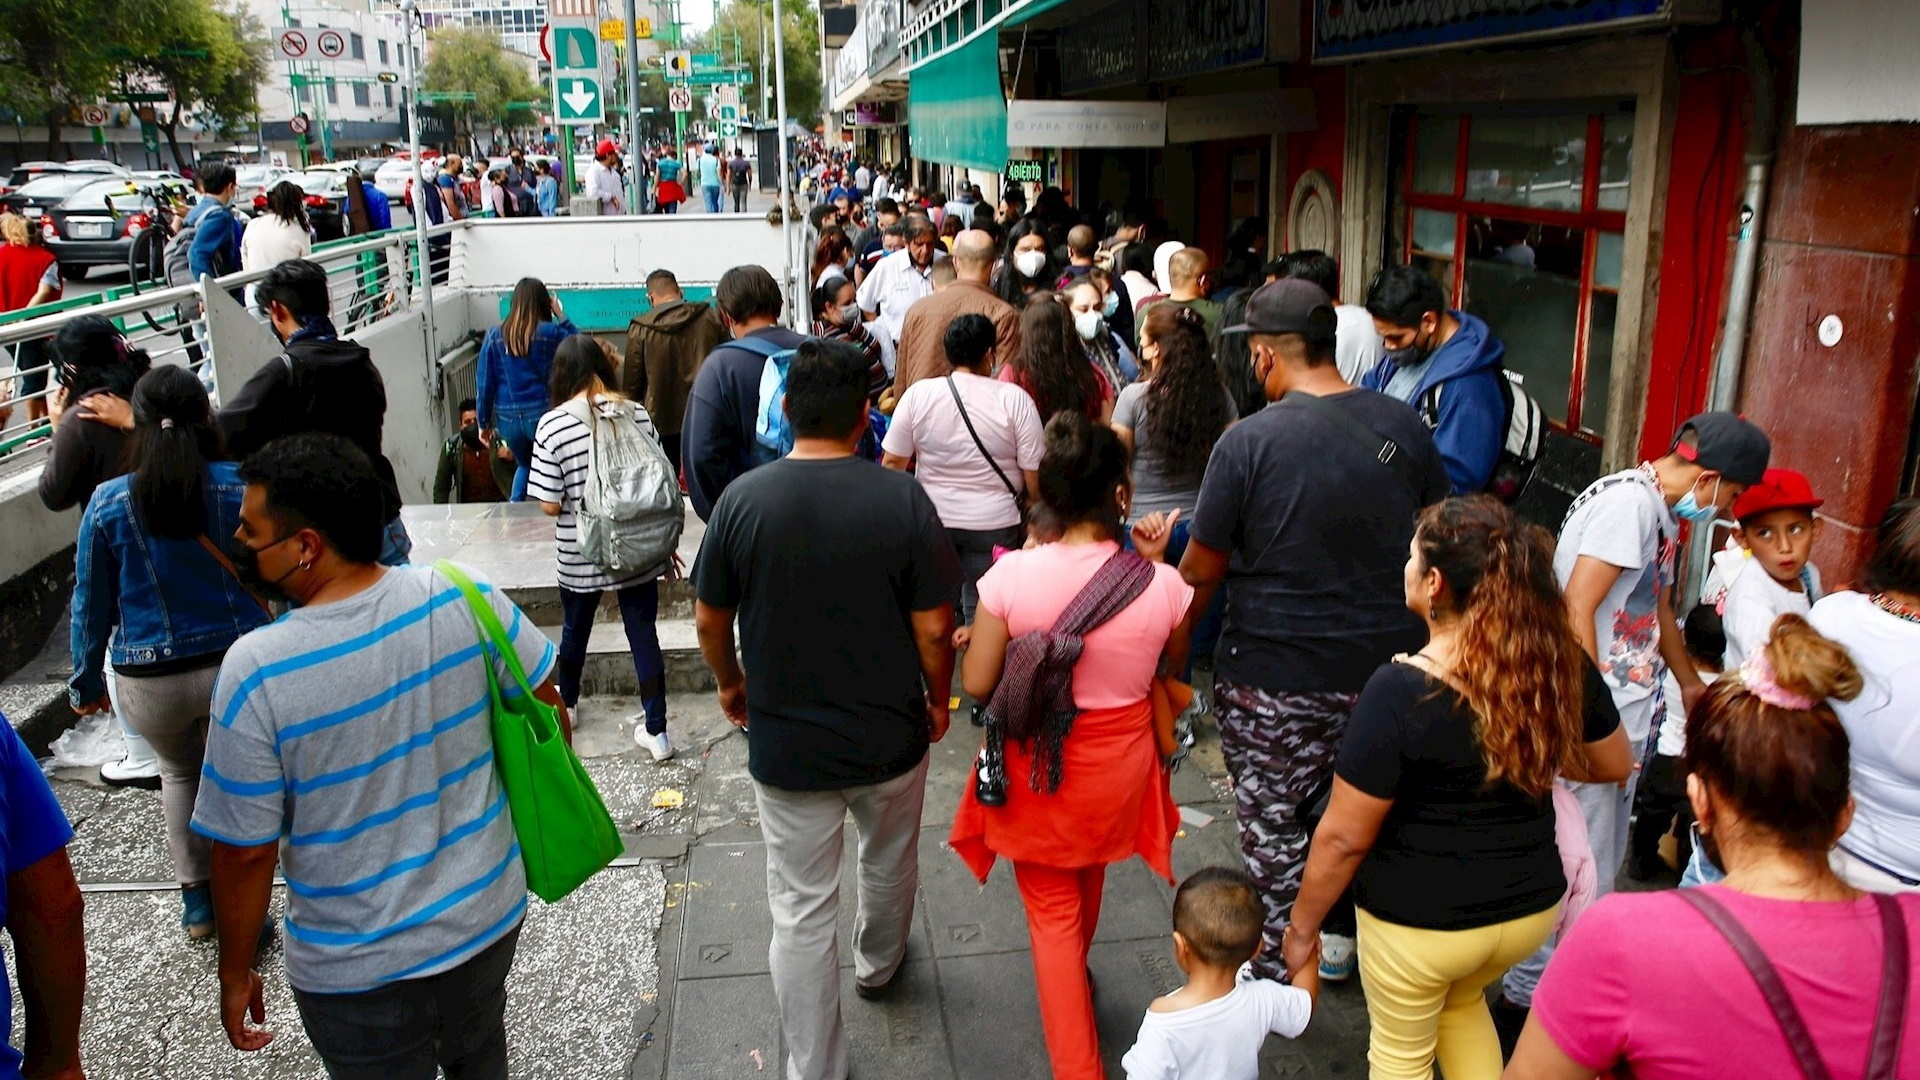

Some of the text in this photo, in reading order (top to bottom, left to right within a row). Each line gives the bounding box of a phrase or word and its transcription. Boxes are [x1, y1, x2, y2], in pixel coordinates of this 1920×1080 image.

[1030, 122, 1061, 131] PARA
[1067, 121, 1108, 131] COMER
[1009, 164, 1042, 180] ABIERTO
[1140, 952, 1169, 995] HISTOR
